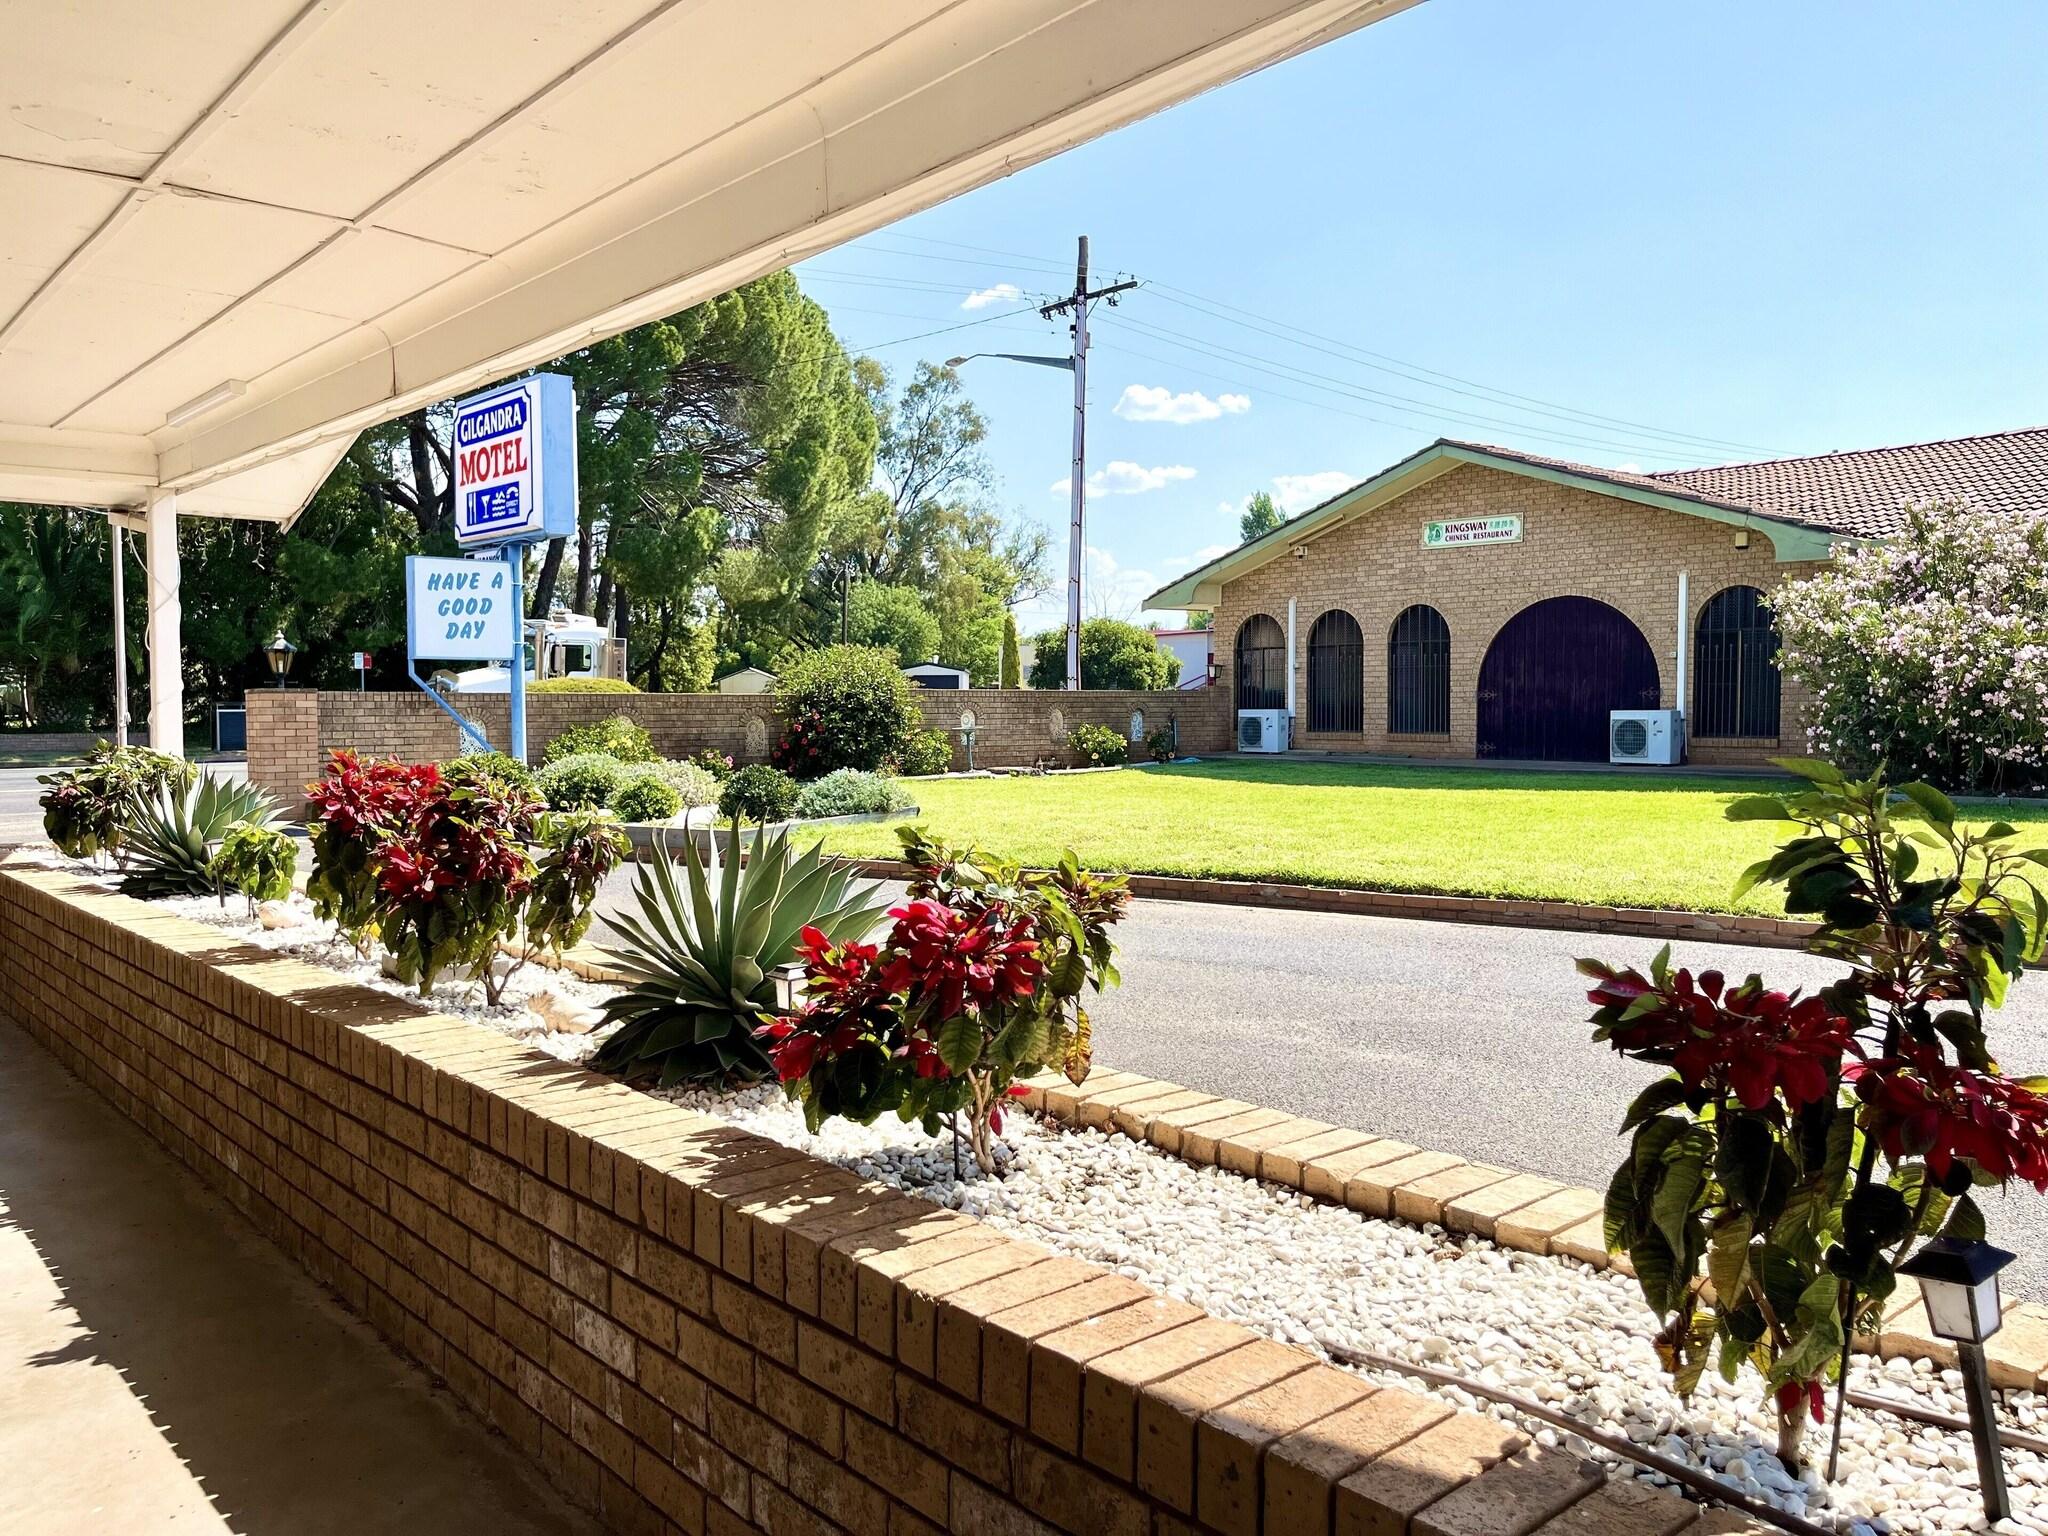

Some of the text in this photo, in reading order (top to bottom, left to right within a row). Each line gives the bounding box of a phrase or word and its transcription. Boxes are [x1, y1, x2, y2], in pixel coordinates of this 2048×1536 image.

[461, 403, 522, 442] GILGANDRA
[460, 437, 527, 487] MOTEL
[1445, 521, 1488, 534] KINGSWAY
[1445, 530, 1513, 542] CHINESE RESTAURANT
[427, 571, 503, 591] HAVE A
[438, 597, 493, 617] GOOD
[445, 620, 486, 640] DAY
